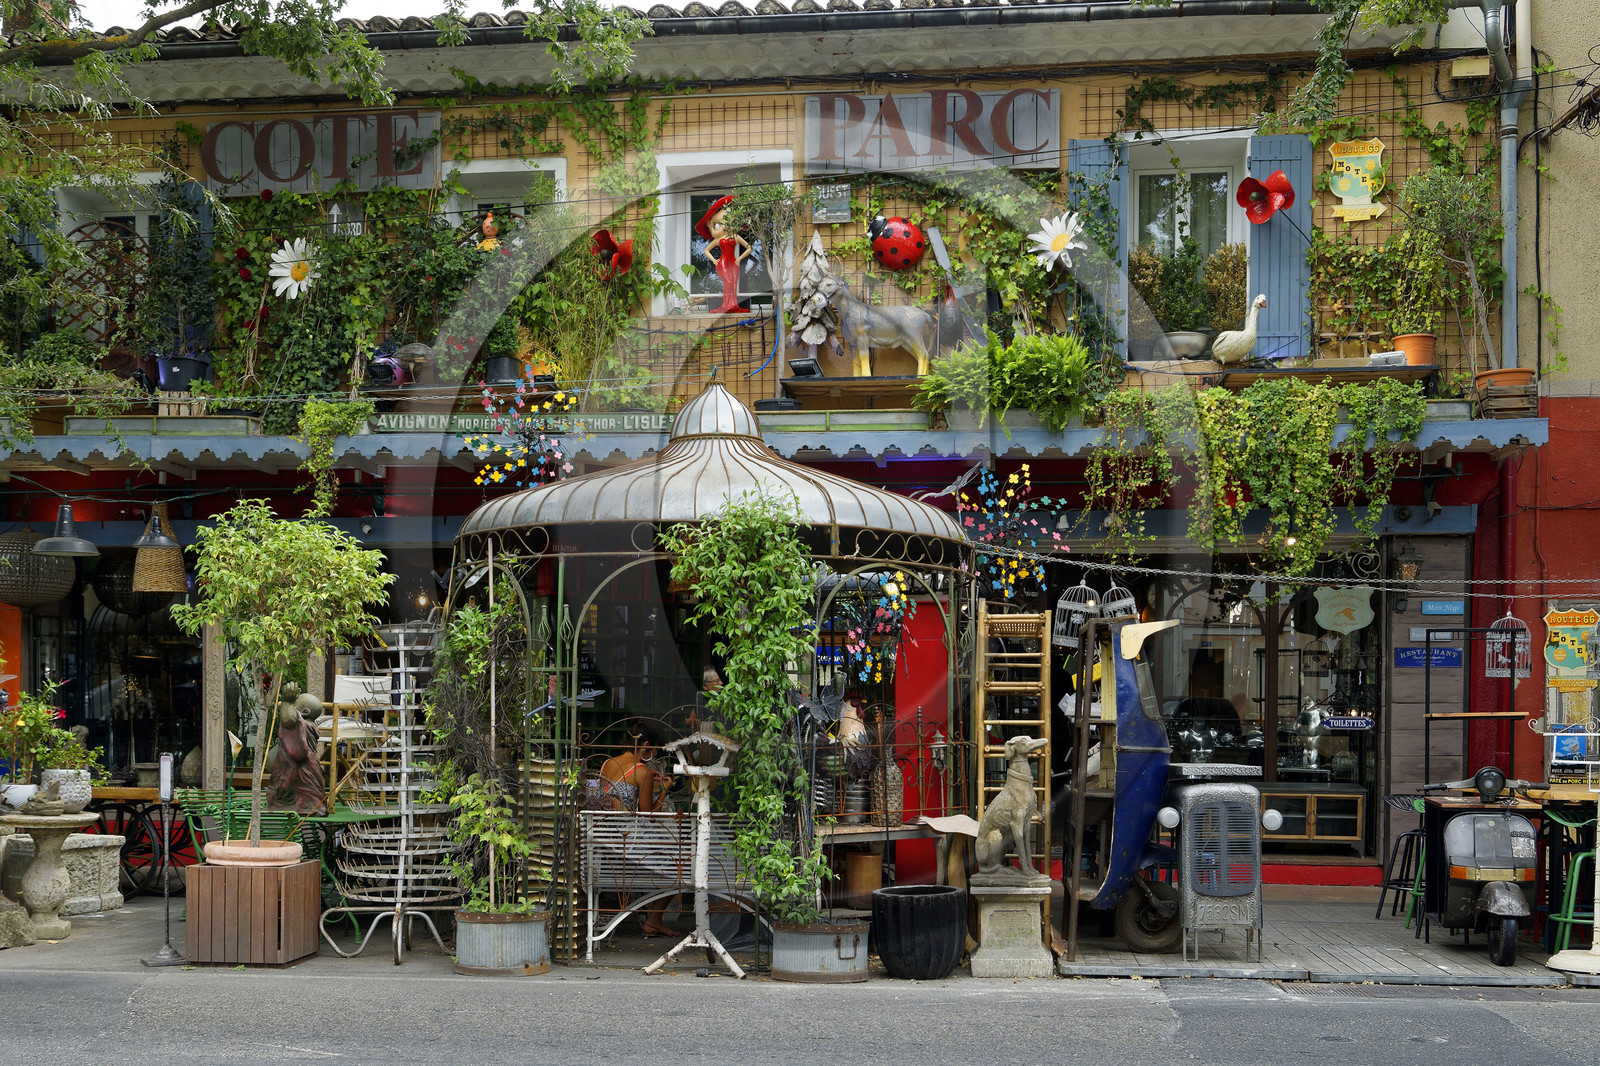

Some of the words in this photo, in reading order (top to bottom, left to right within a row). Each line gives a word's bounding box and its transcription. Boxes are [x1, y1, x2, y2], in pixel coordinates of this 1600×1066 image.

[200, 110, 425, 185] COTE
[810, 88, 1051, 160] PARC
[1334, 145, 1365, 154] ROUTE
[1367, 144, 1380, 153] 66
[377, 414, 450, 429] AVIGNON
[457, 416, 511, 430] MORIÈRS
[588, 418, 616, 430] THOR
[623, 414, 668, 430] L'ISLE
[1549, 616, 1581, 624] ROUTE
[1582, 614, 1596, 624] 66
[1400, 648, 1458, 659] RESTARANT
[1329, 719, 1367, 727] TOILETTES
